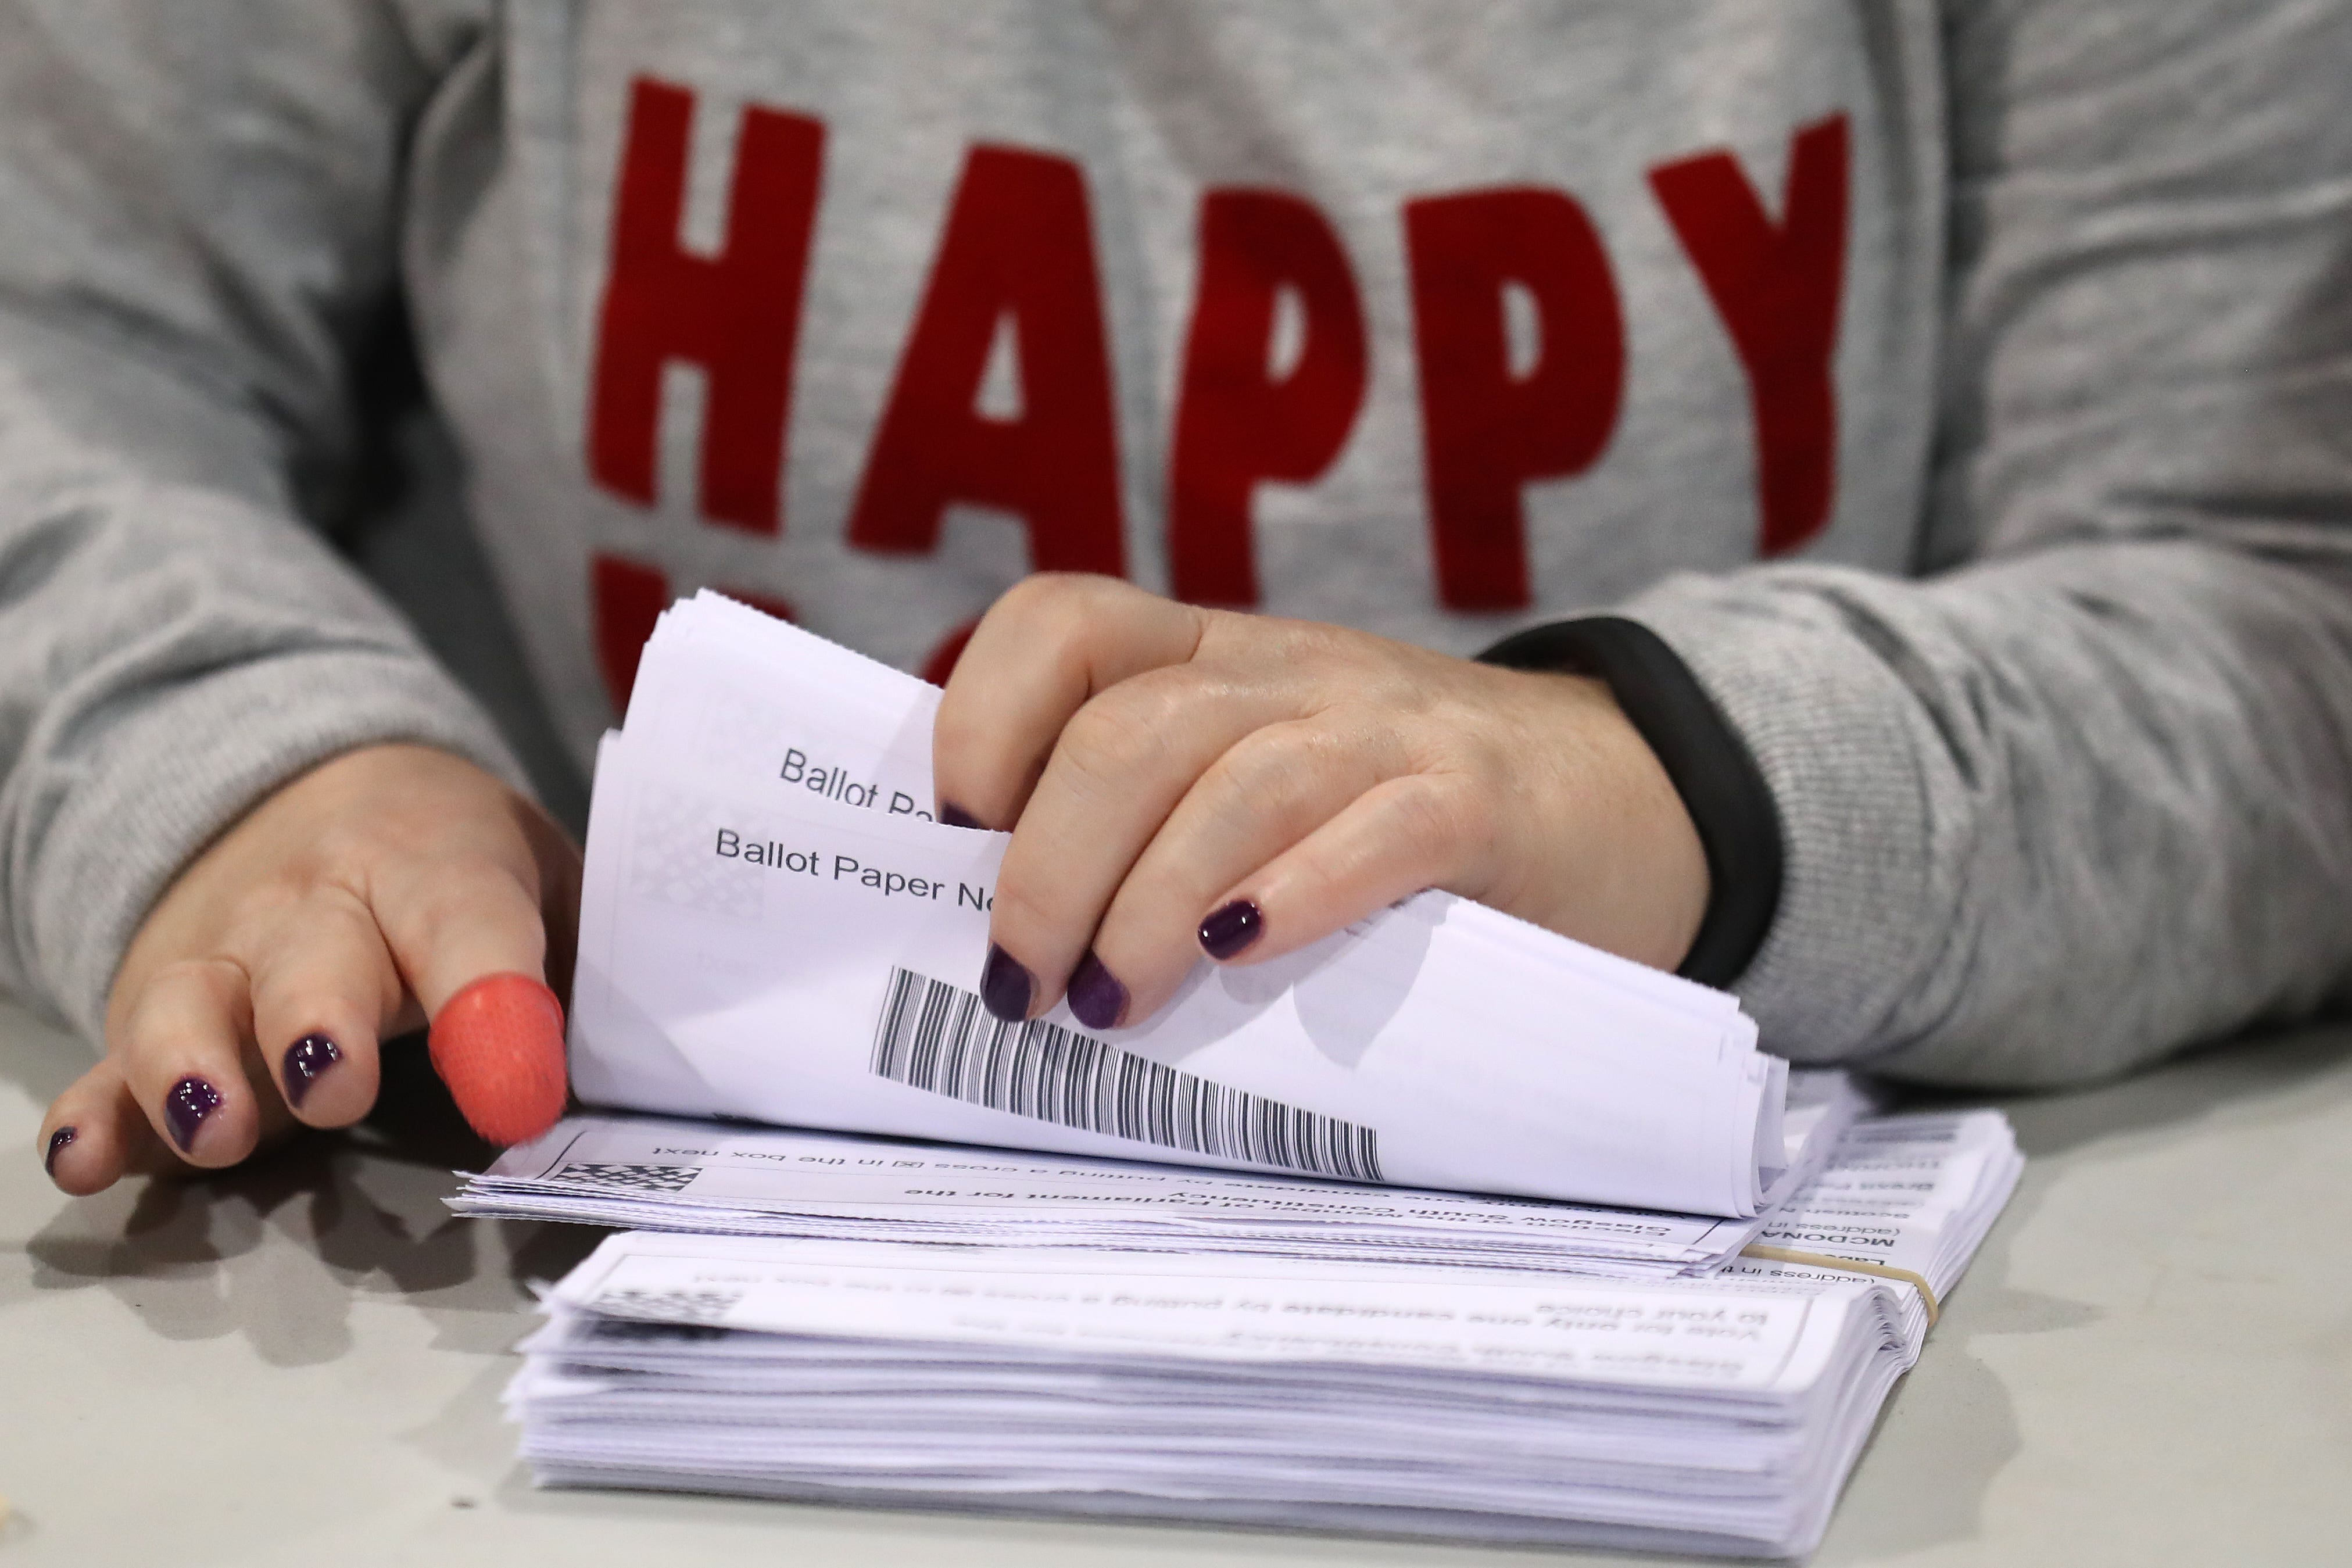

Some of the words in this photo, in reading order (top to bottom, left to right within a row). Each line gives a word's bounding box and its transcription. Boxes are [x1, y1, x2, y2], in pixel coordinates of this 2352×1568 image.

[587, 76, 1851, 613] HAPPY
[779, 747, 879, 809] Ballot
[716, 827, 820, 876] Ballot
[833, 855, 945, 899] Paper
[958, 882, 993, 912] N
[651, 1147, 720, 1157] next
[730, 1152, 786, 1162] box
[798, 1157, 847, 1165] the
[858, 1159, 885, 1167] in
[935, 1164, 1018, 1173] cross
[1058, 1170, 1166, 1182] putting
[1224, 1184, 1391, 1198] candidate
[1026, 1194, 1211, 1207] Parliament
[1168, 1192, 1395, 1213] Constituency
[1265, 1206, 1404, 1219] Member
[1408, 1209, 1509, 1220] South
[1520, 1217, 1672, 1232] Glasgow
[1795, 1222, 1901, 1237] (address
